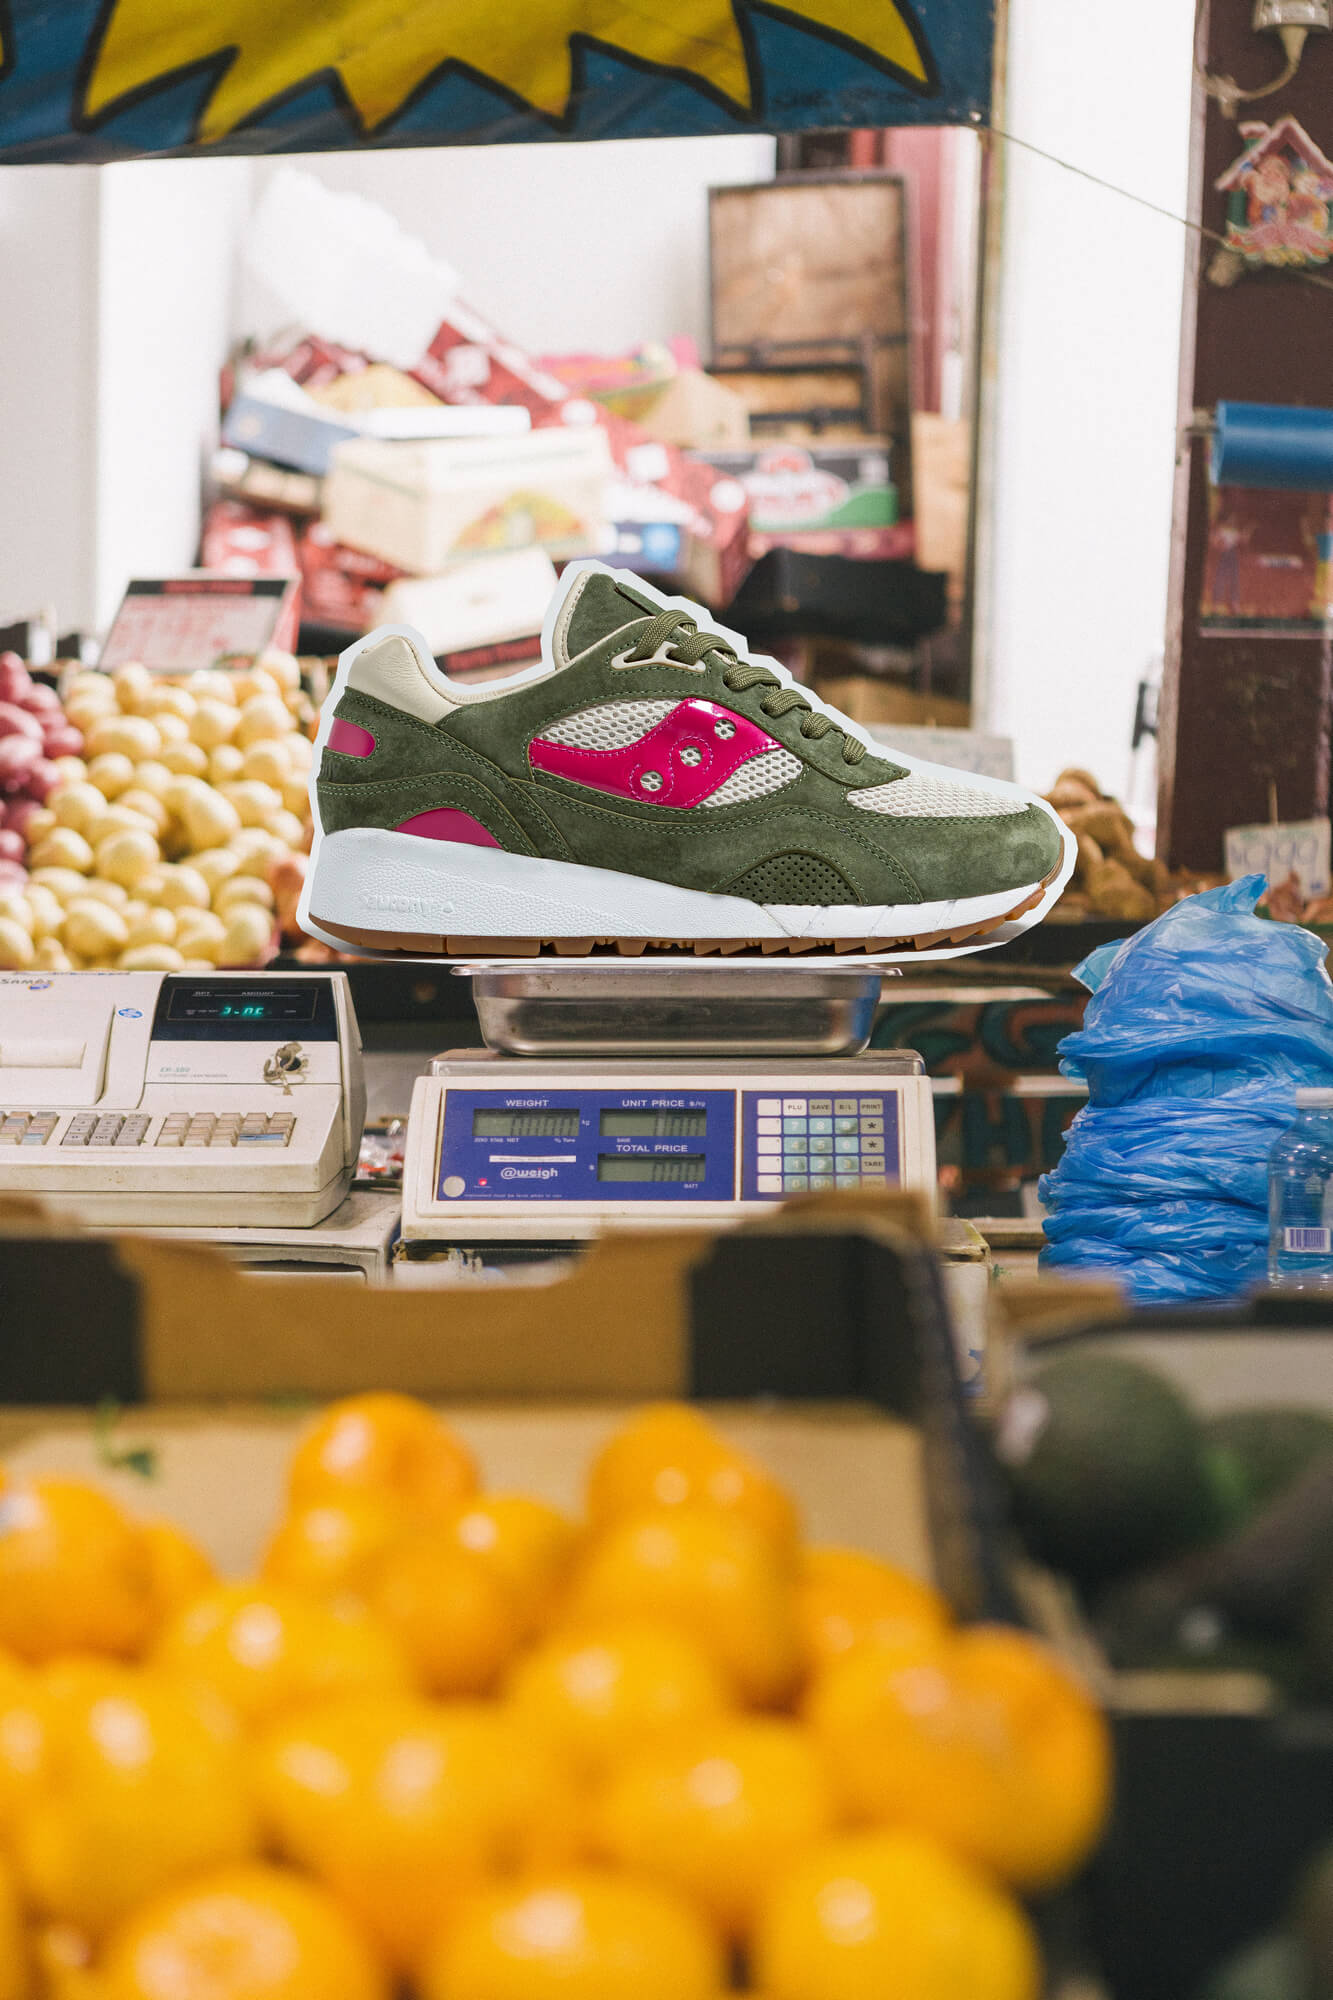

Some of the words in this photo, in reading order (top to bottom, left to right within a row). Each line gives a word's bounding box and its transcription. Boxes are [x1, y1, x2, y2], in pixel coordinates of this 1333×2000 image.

[506, 1099, 549, 1107] WEIGHT
[622, 1099, 648, 1107] UNIT
[652, 1099, 685, 1107] PRICE
[616, 1144, 650, 1152] TOTAL
[655, 1144, 688, 1152] PRICE
[501, 1167, 558, 1180] @weigh
